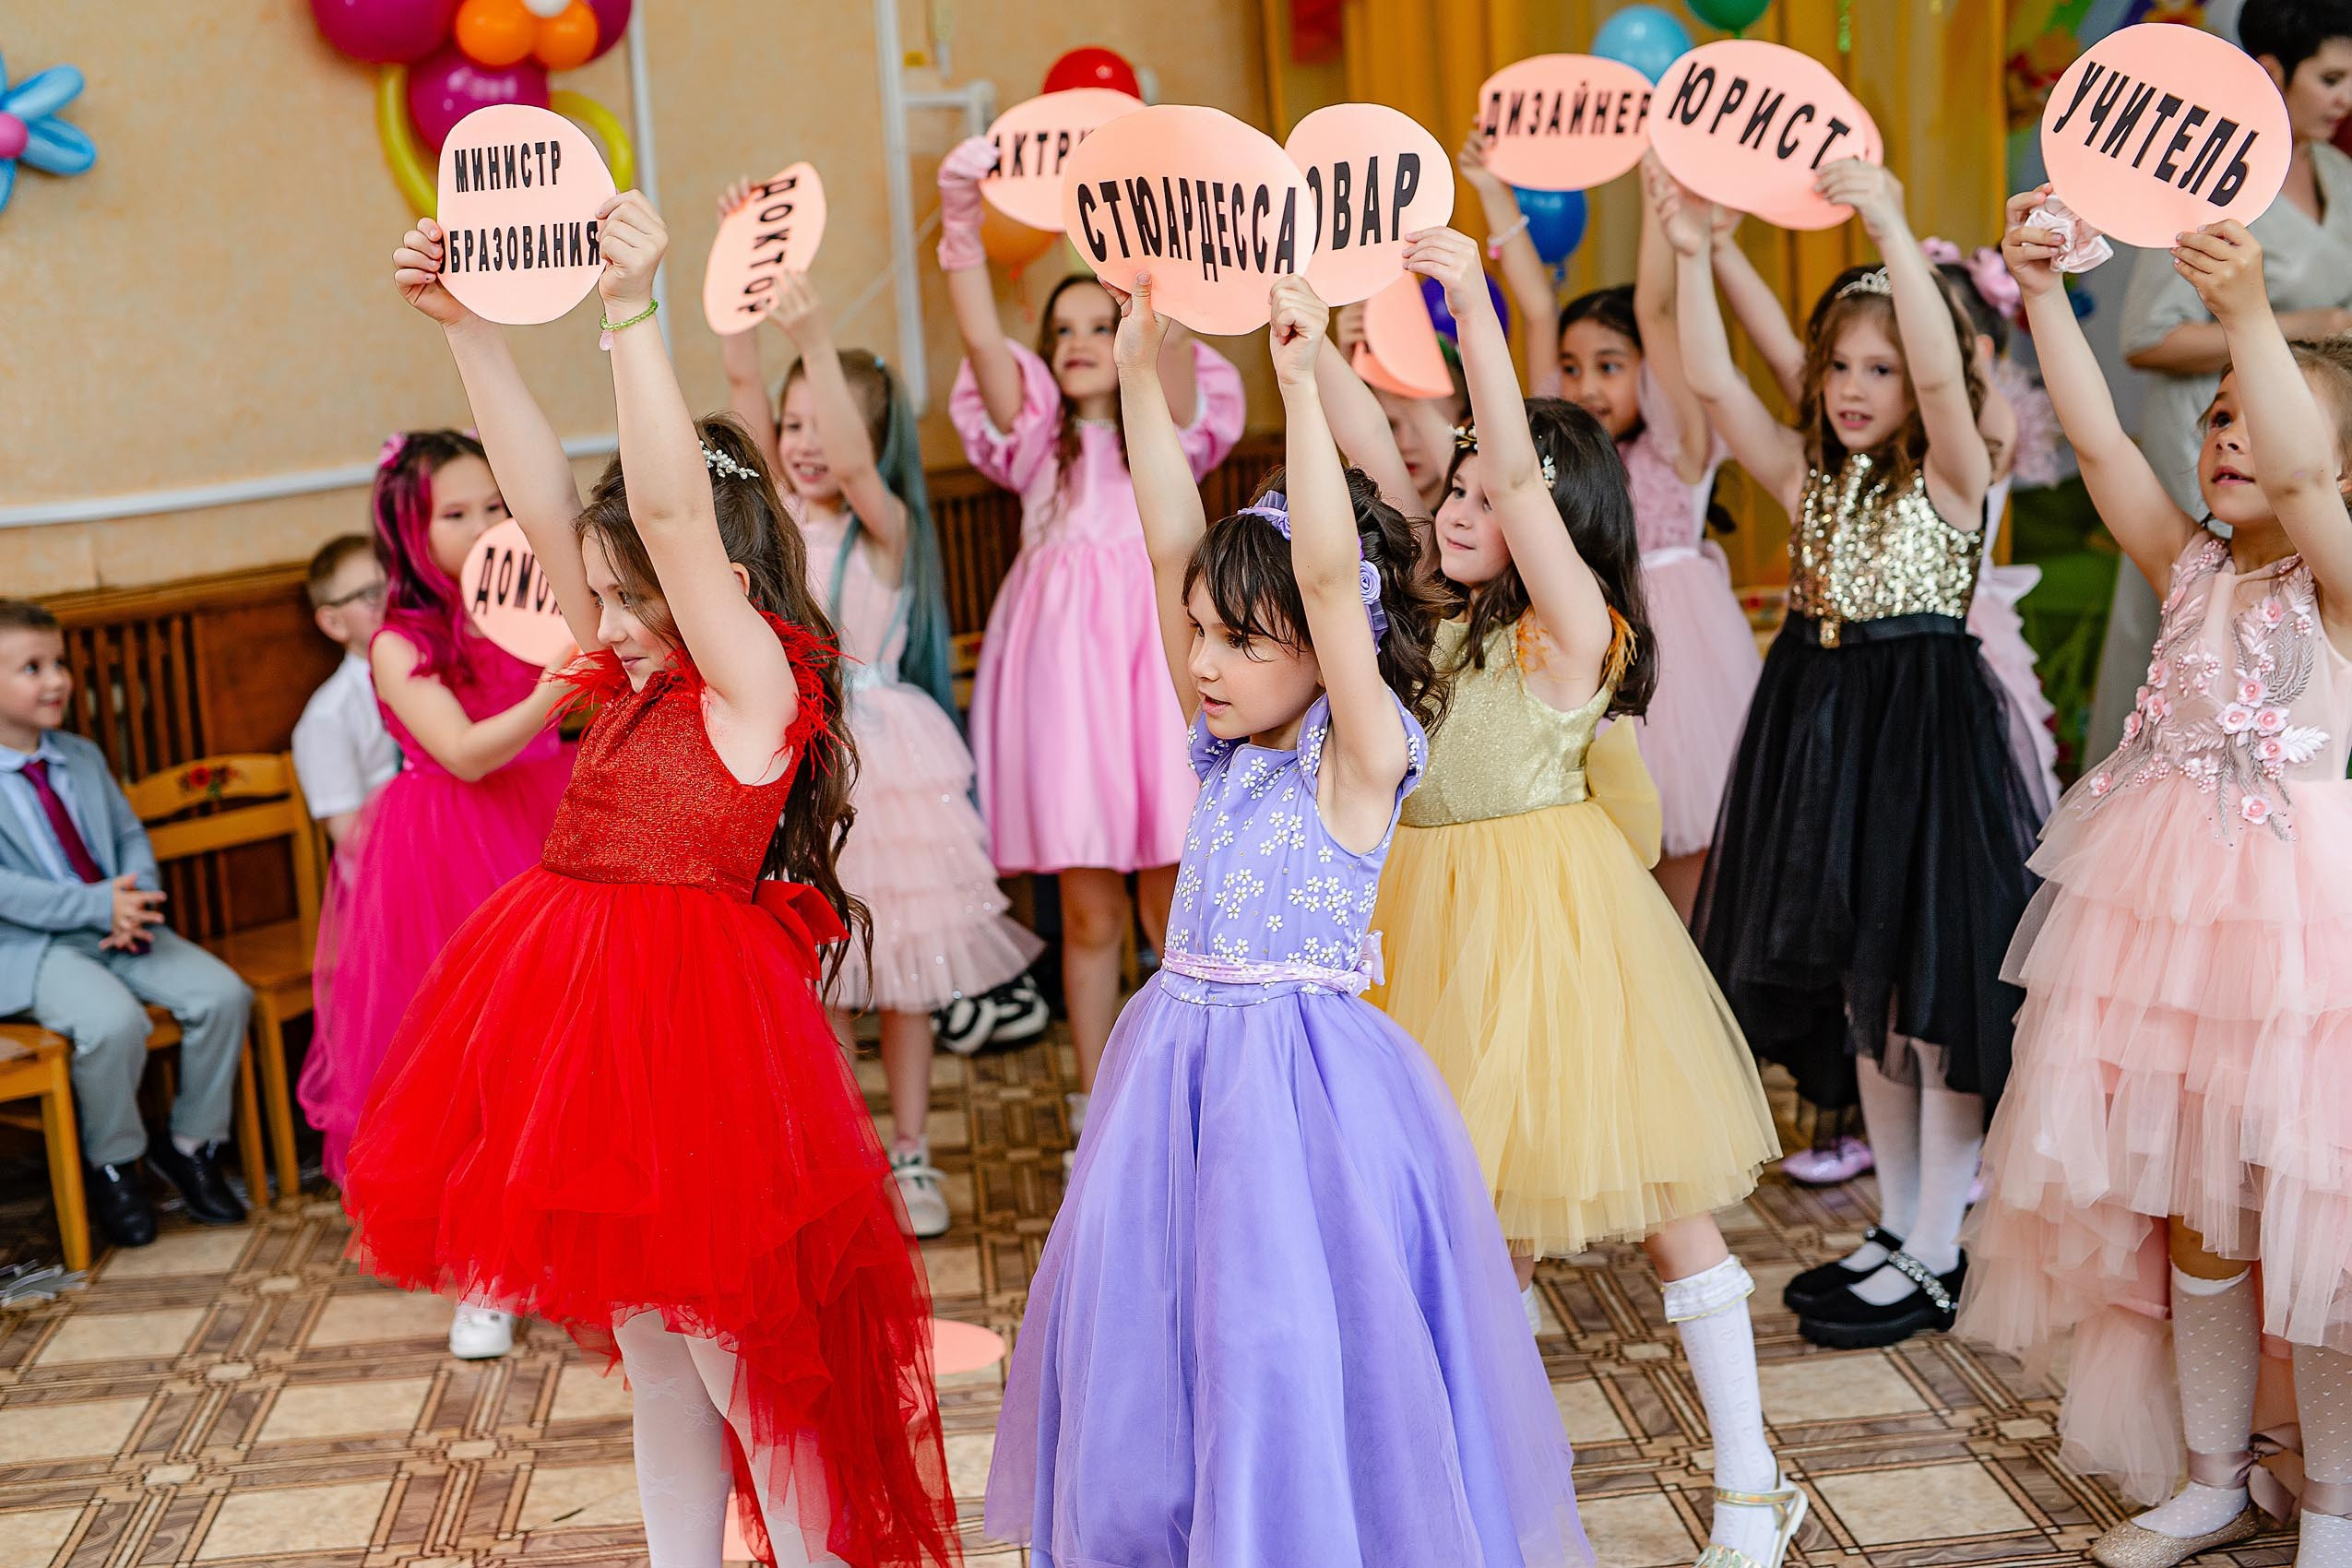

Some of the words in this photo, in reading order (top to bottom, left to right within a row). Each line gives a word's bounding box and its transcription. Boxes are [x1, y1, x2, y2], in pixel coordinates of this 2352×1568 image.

[988, 130, 1095, 177] АКТР
[1484, 79, 1652, 146] ДИЗАЙНЕР
[1668, 62, 1850, 170] ЮРИСТ
[2052, 61, 2260, 207] УЧИТЕЛЬ
[454, 140, 562, 193] МИНИСТР
[1077, 176, 1297, 282] СТЮАРДЕССА
